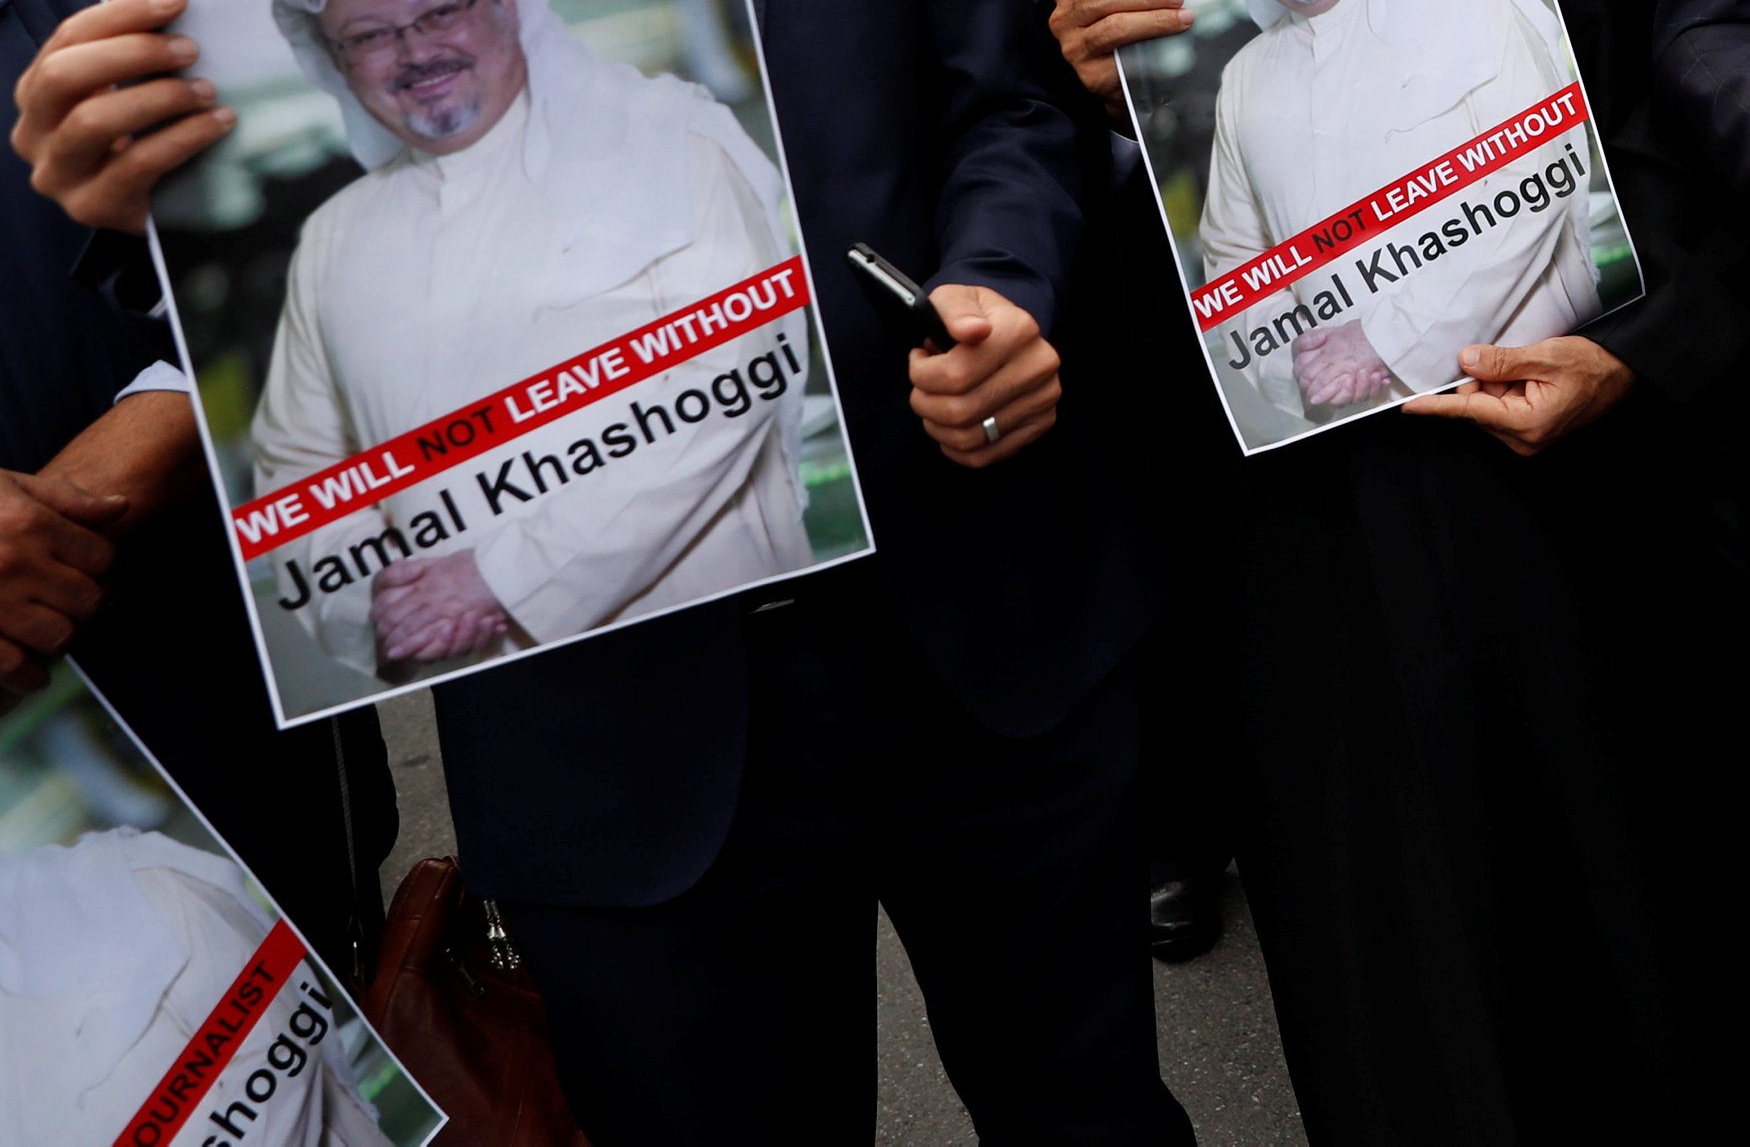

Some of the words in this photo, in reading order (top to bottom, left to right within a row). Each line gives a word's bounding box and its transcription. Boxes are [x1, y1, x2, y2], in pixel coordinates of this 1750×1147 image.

[1193, 279, 1244, 319] WE
[1241, 245, 1313, 292] WILL
[1312, 208, 1367, 254] NOT
[1371, 160, 1459, 222] LEAVE
[1457, 92, 1577, 173] WITHOUT
[1228, 274, 1354, 371] Jamal
[1355, 144, 1586, 293] Khashoggi
[235, 493, 310, 544] WE
[309, 451, 416, 510] WILL
[416, 406, 497, 462] NOT
[503, 348, 629, 424] LEAVE
[629, 268, 796, 365] WITHOUT
[277, 490, 467, 612] Jamal
[476, 332, 802, 516] Khashoggi
[125, 960, 275, 1147] OURNALIST
